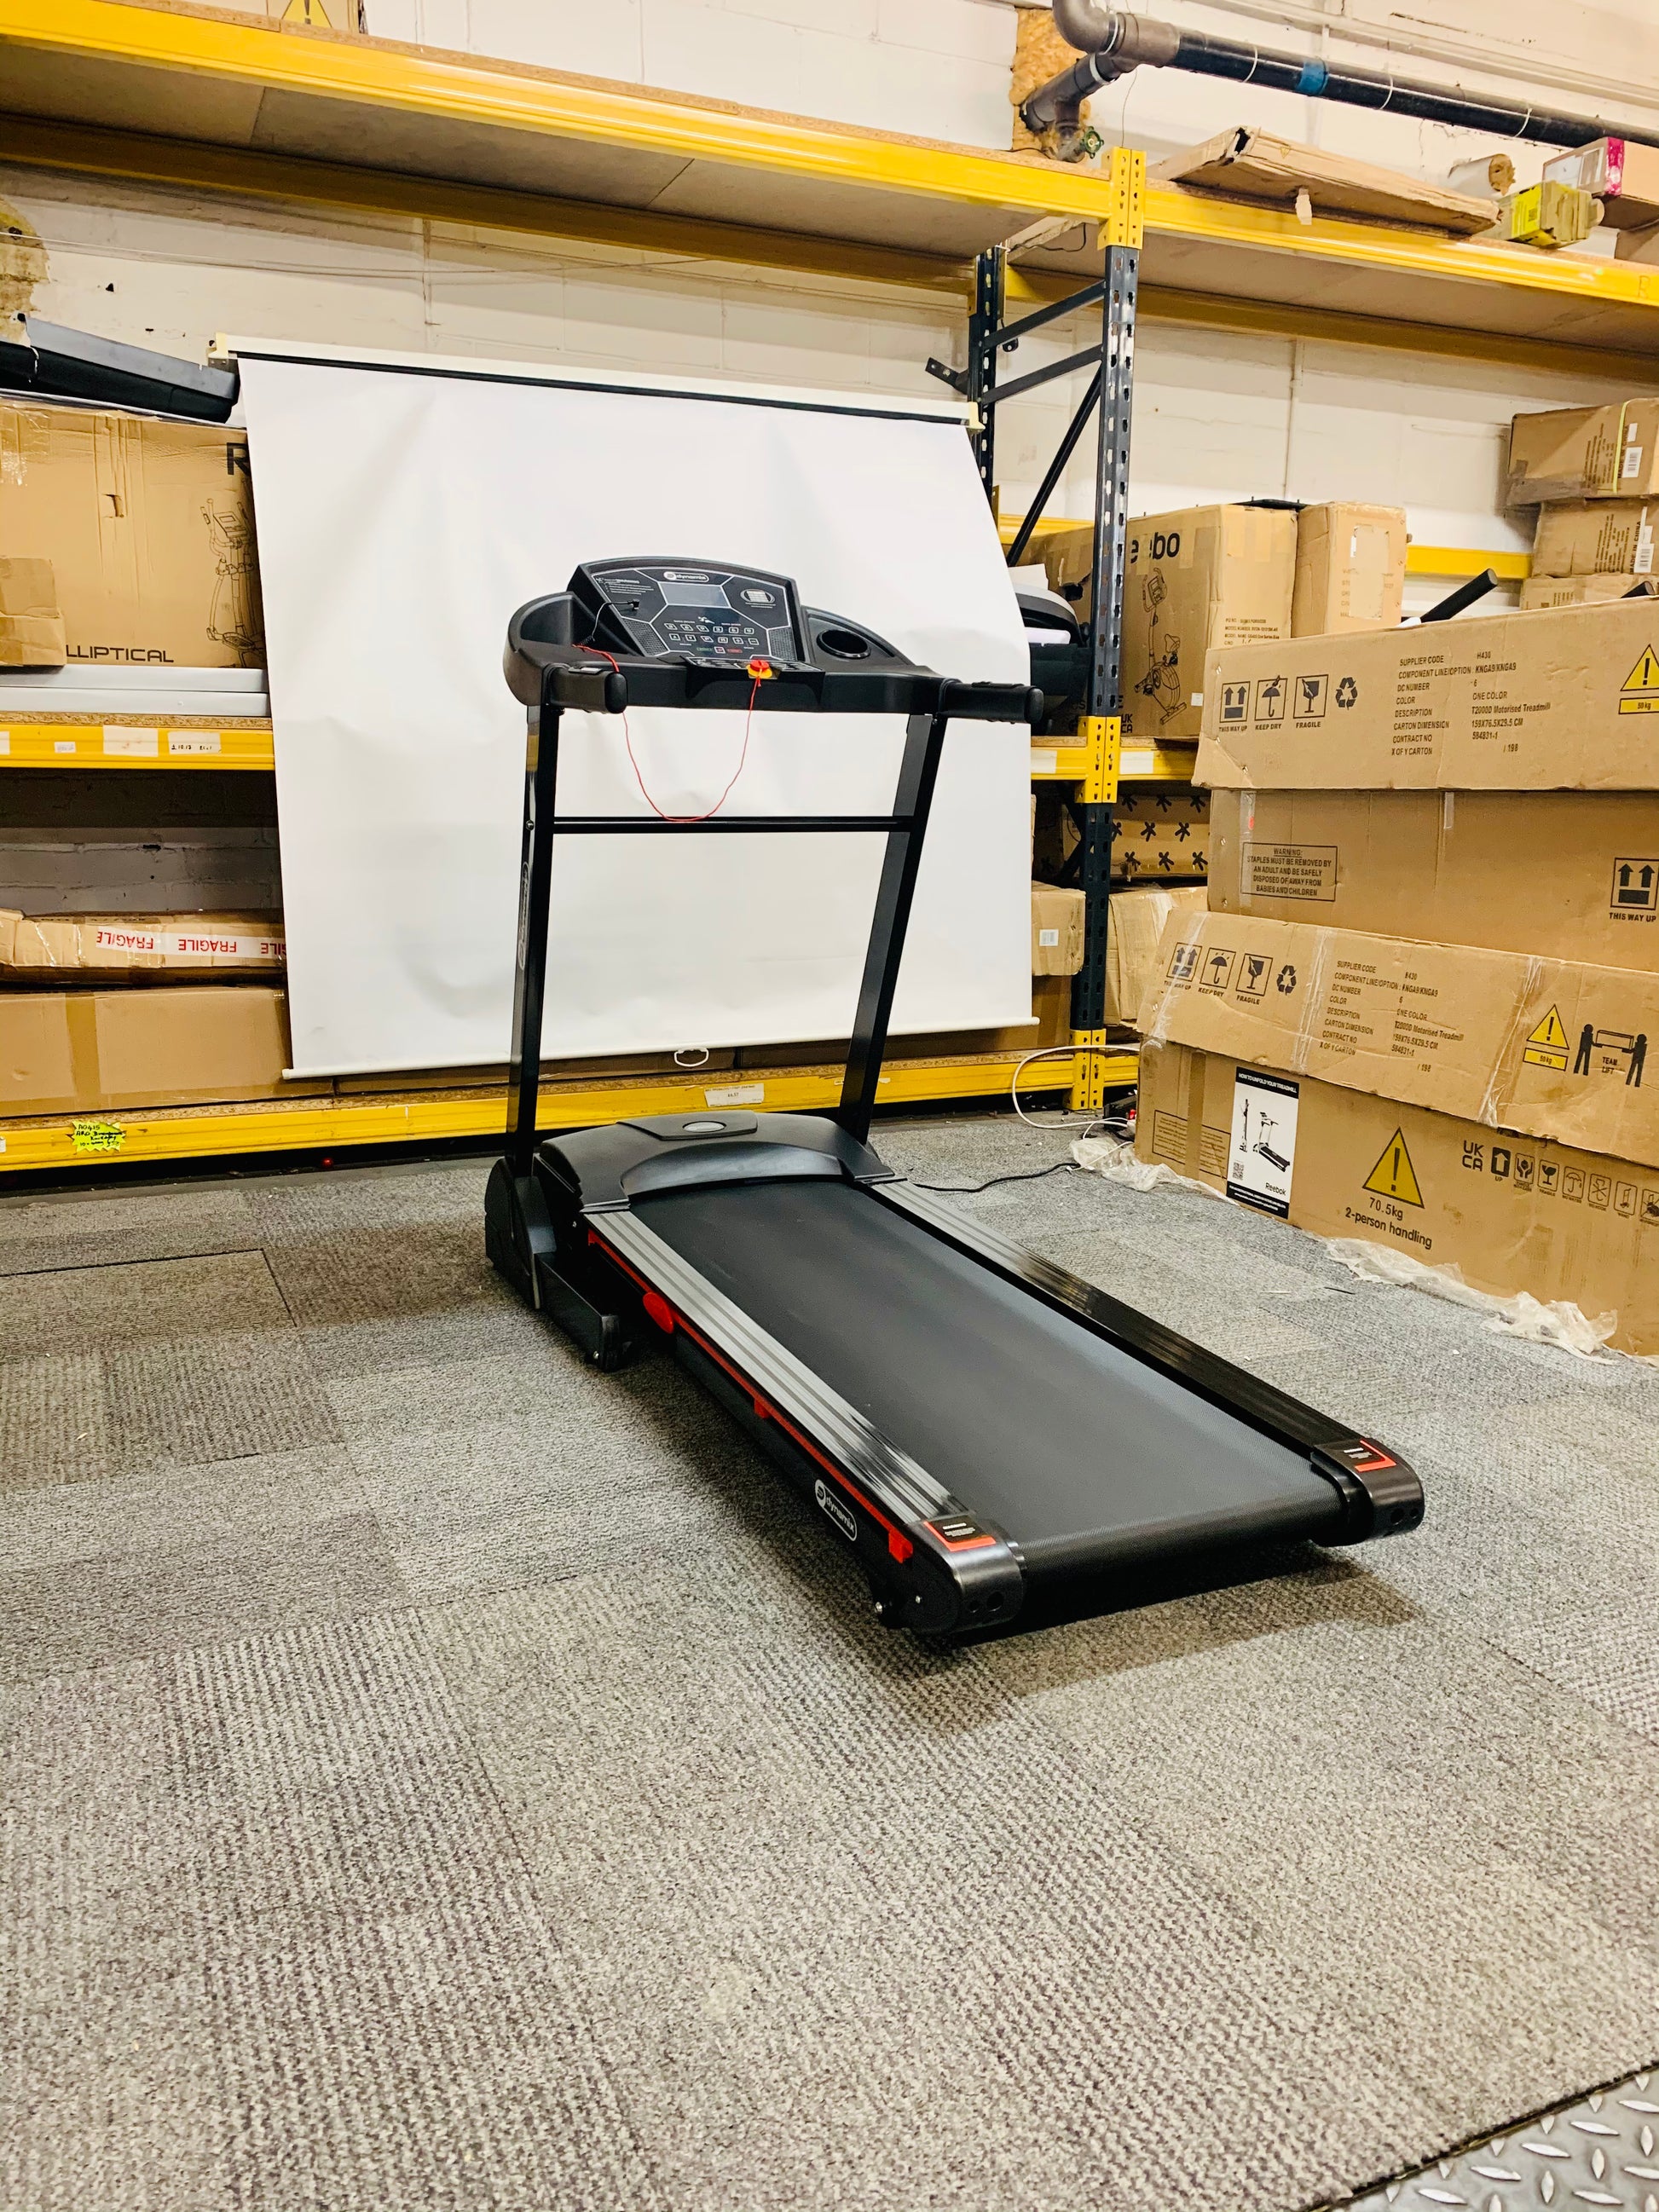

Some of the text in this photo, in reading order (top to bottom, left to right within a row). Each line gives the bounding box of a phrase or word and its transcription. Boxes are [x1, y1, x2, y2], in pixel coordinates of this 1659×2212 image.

[1400, 655, 1444, 667] SUPPLIER CODE
[1398, 669, 1434, 679] COMPONENT
[1397, 682, 1431, 692] DC NUMBER
[1396, 696, 1415, 705] COLOR
[1472, 690, 1508, 701] ONE COLOR
[1493, 704, 1522, 713] Motorised
[1523, 702, 1551, 712] Treadmill
[1645, 702, 1651, 710] kg
[1395, 708, 1433, 718] DESCRIPTION
[1393, 720, 1450, 731] CARTON DIMENSION
[1513, 718, 1523, 726] CM
[1392, 734, 1432, 743] CONTRACT NO
[1409, 747, 1432, 756] CARTON
[1247, 855, 1270, 864] STAPLES
[1270, 857, 1286, 865] MUST
[1286, 858, 1294, 866] BE
[1295, 858, 1323, 867] REMOVED
[1280, 867, 1291, 875] AND
[1300, 869, 1322, 877] SAFELY
[1253, 875, 1280, 884] DISPOSED
[1288, 877, 1305, 886] AWAY
[1256, 885, 1275, 893] BABIES
[1288, 887, 1318, 896] CHILDREN
[1610, 912, 1626, 921] THIS
[96, 931, 154, 950] FRAGILE
[178, 939, 237, 953] FRAGILE
[1337, 960, 1377, 973] SUPPLIER CODE
[1334, 972, 1367, 985] COMPONENT
[1198, 986, 1212, 995] KEEP
[1332, 983, 1361, 996] DC NUMBER
[1236, 995, 1260, 1005] FRAGILE
[1329, 996, 1347, 1005] COLOR
[1327, 1007, 1361, 1019] DESCRIPTION
[1408, 1011, 1428, 1021] COLOR
[1324, 1019, 1374, 1036] CARTON DIMENSION
[1322, 1030, 1350, 1042] CONTRACT
[1413, 1025, 1439, 1037] Motorised
[1439, 1030, 1465, 1042] Treadmill
[1335, 1045, 1356, 1056] CARTON
[1546, 1056, 1552, 1065] kg
[1602, 1056, 1618, 1066] TEAM
[1602, 1066, 1615, 1075] LIFT
[1463, 1140, 1484, 1158] UK
[1462, 1154, 1483, 1172] CA
[1265, 1182, 1286, 1196] Reebok
[1369, 1197, 1403, 1222] 70.5kg
[1345, 1207, 1432, 1250] 2-person handling
